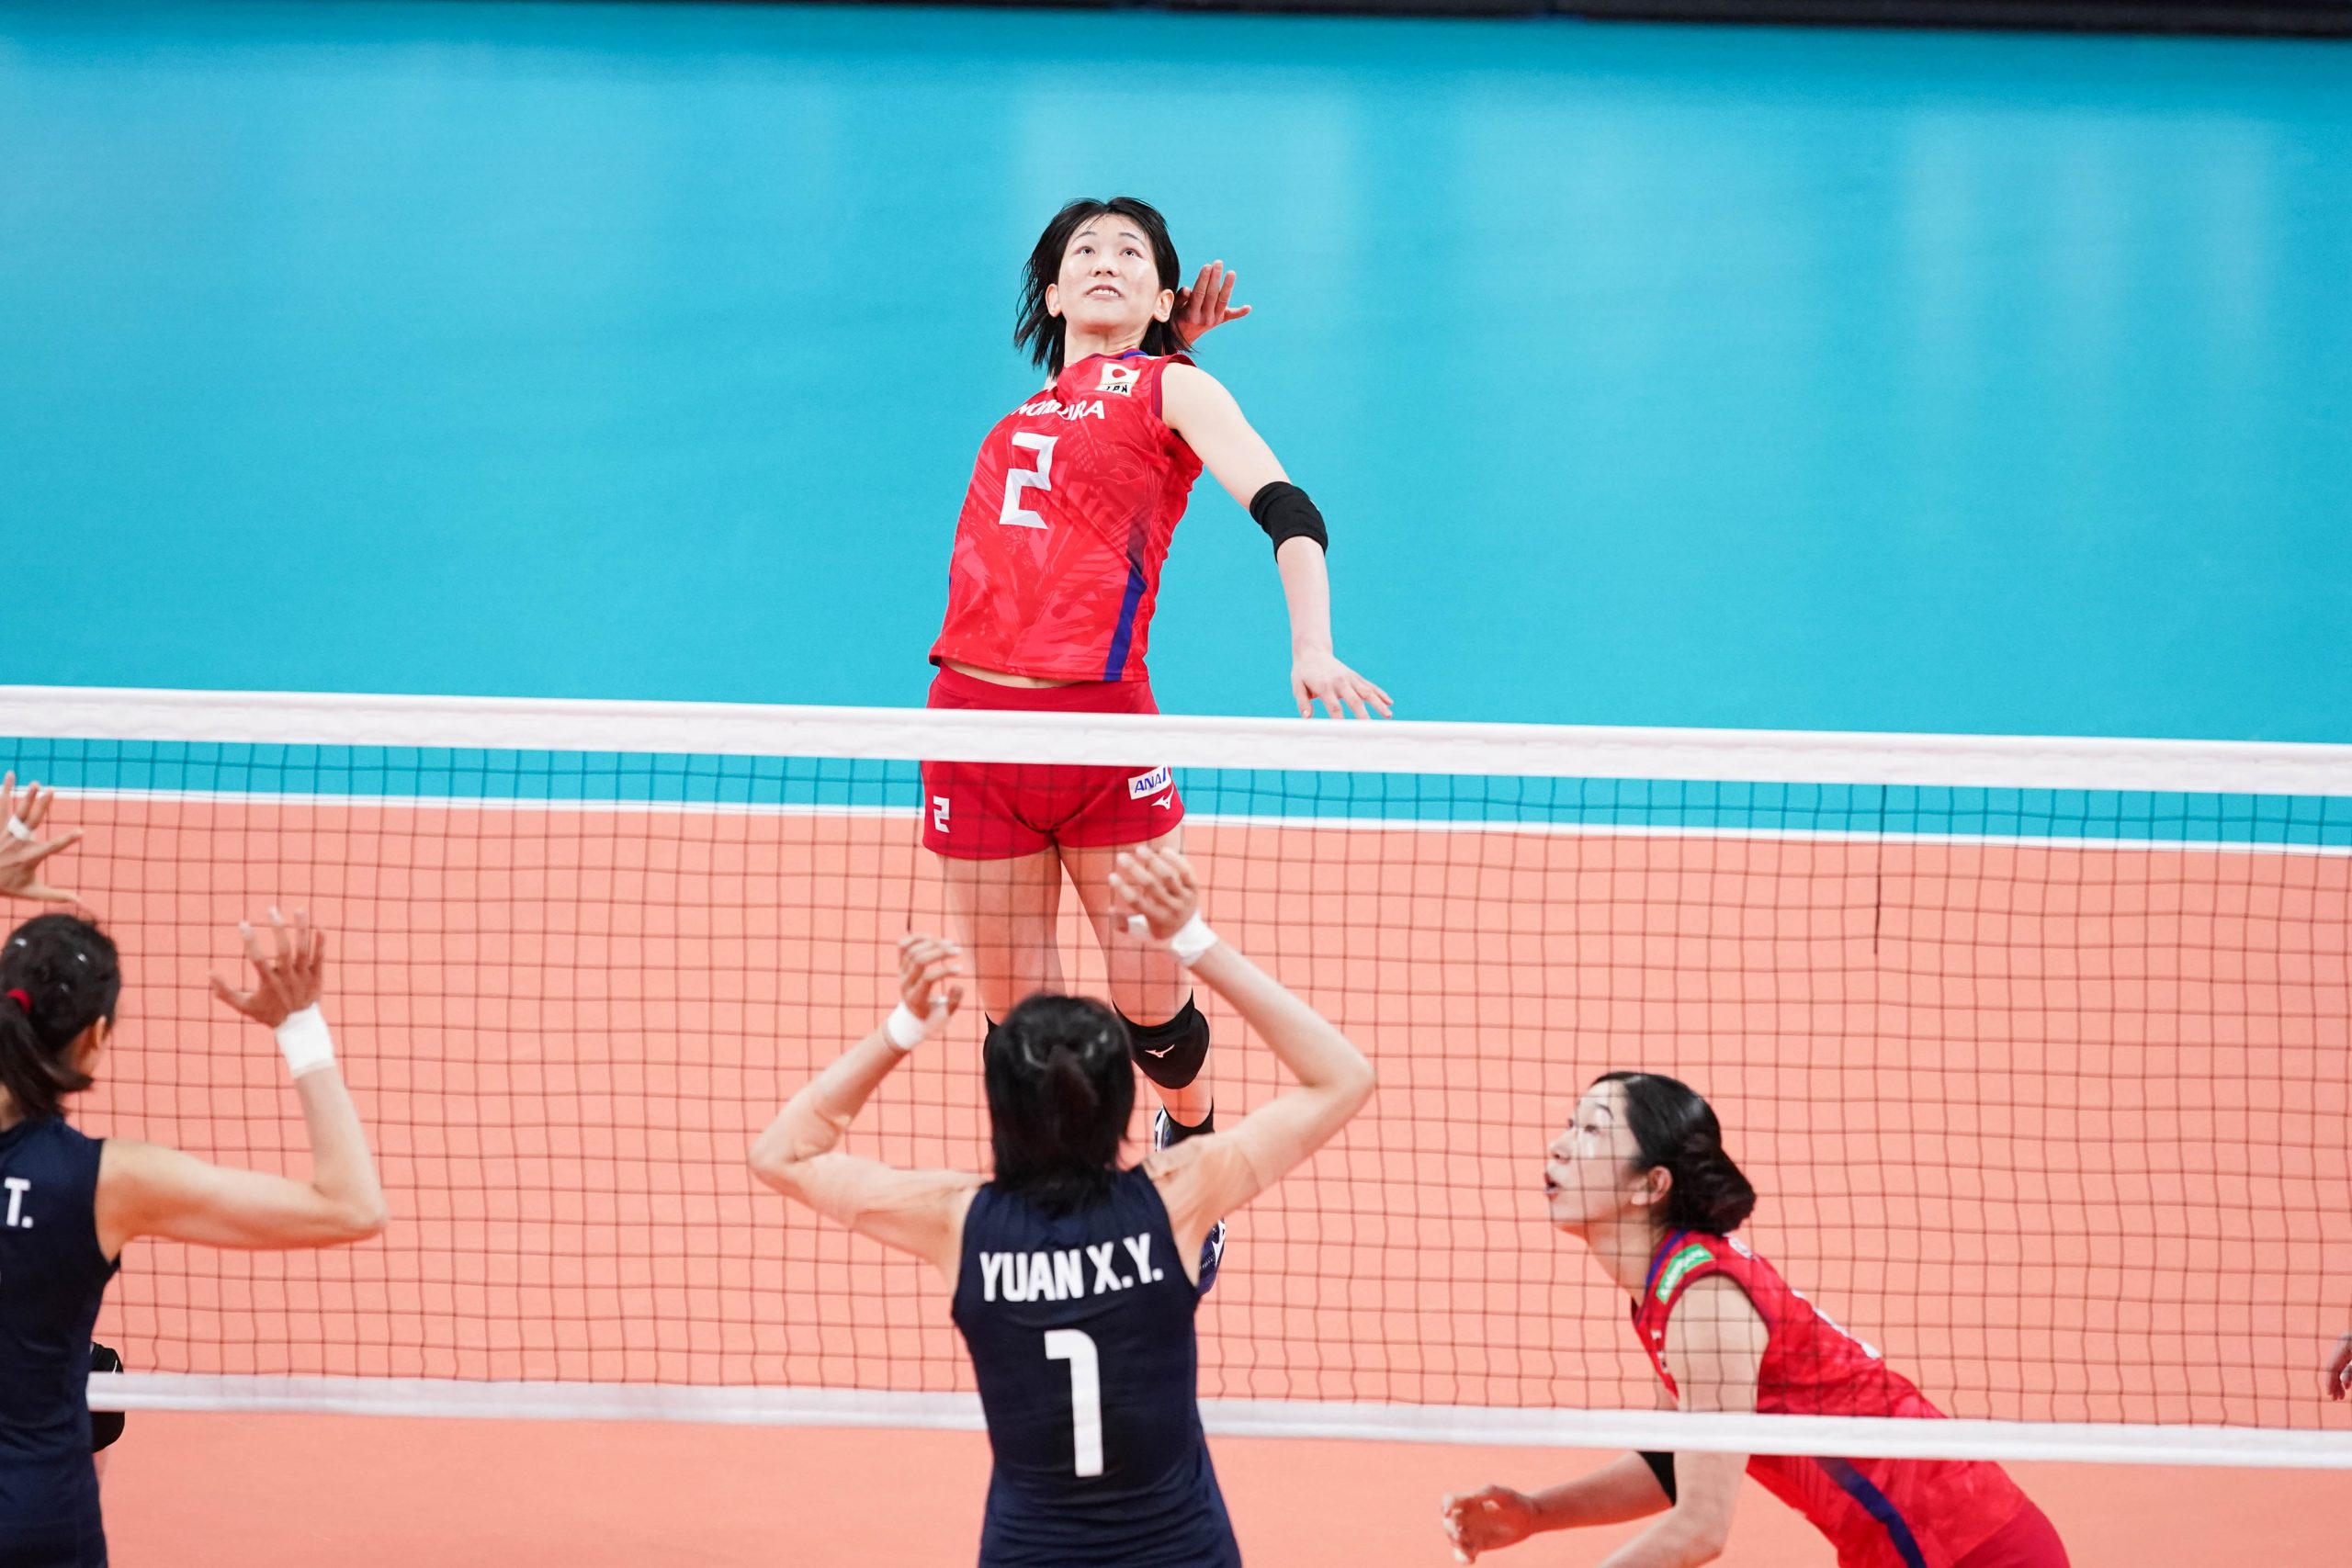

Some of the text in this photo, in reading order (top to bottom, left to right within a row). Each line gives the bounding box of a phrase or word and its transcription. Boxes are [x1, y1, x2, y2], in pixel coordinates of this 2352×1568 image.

[1000, 432, 1058, 529] 2
[933, 796, 950, 832] 2
[979, 1233, 1164, 1302] YUAN X.Y.
[1044, 1328, 1103, 1478] 1
